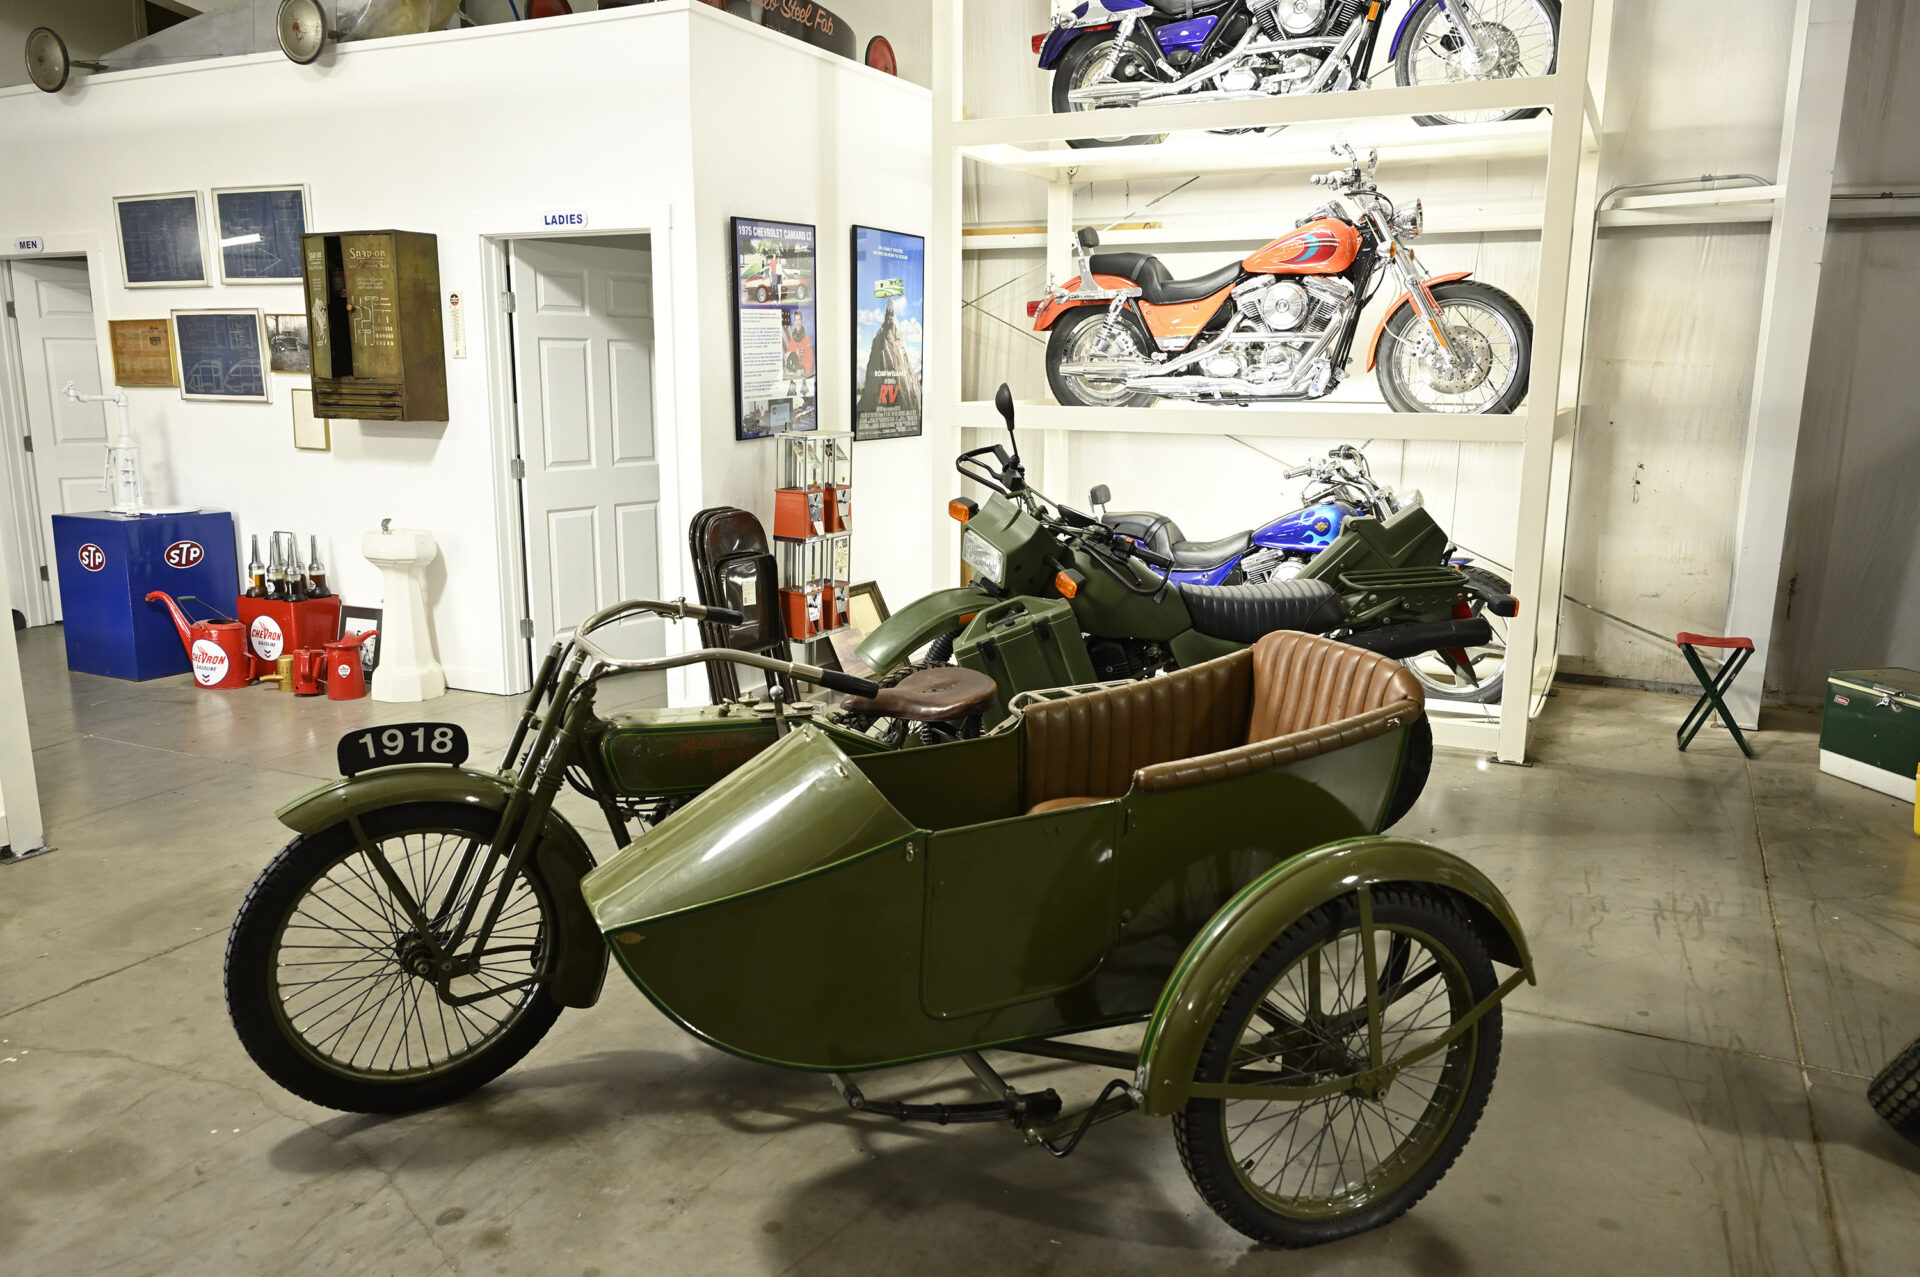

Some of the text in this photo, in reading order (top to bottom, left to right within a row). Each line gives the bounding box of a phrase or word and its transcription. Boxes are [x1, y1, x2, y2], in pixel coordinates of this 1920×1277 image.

[544, 213, 583, 225] LADIES
[738, 225, 752, 236] 1975
[753, 226, 783, 238] CHEVROLET
[783, 229, 806, 240] CAMARO
[19, 240, 38, 249] MEN
[349, 247, 386, 259] Snap-on
[878, 384, 899, 405] RV
[82, 546, 103, 568] STP
[169, 543, 200, 565] STP
[251, 627, 282, 641] CHEVRON
[192, 651, 226, 665] CHEVRON
[359, 727, 454, 759] 1918
